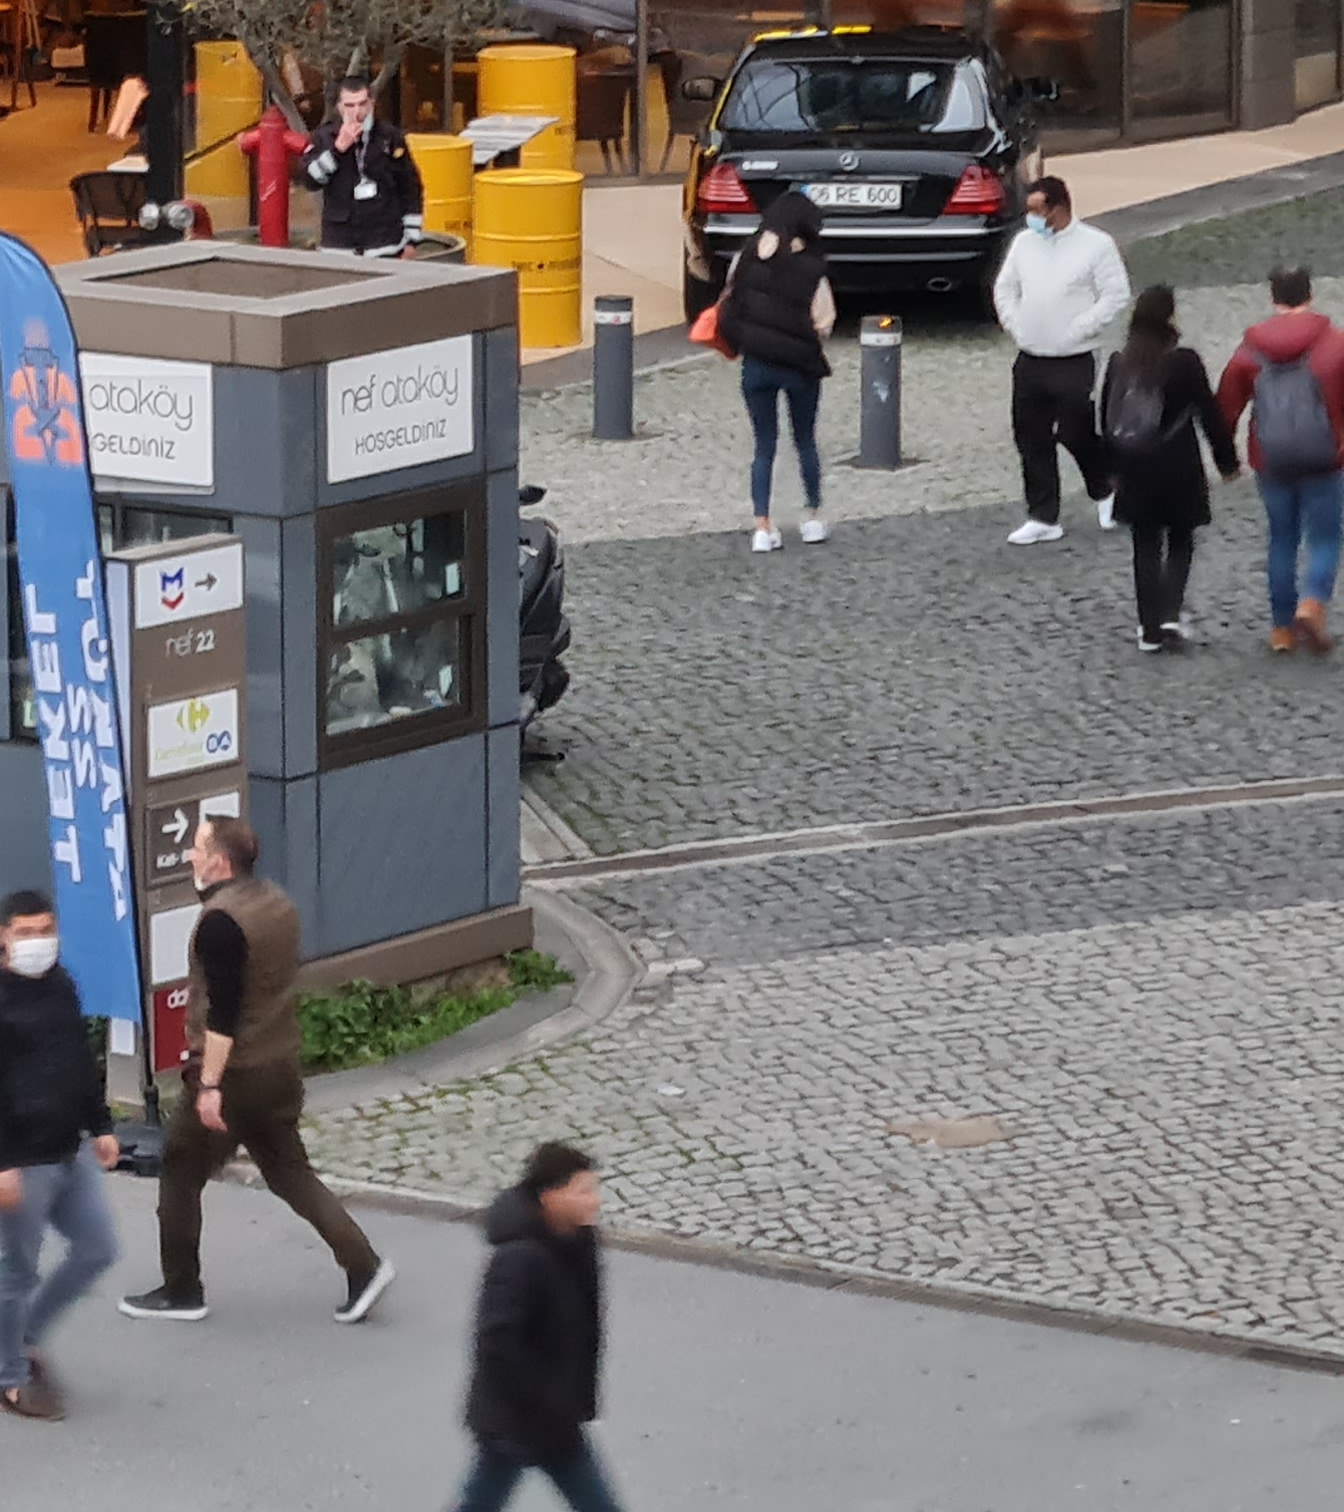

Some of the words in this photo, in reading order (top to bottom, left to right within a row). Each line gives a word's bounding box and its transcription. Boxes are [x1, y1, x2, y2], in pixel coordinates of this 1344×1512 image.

[835, 187, 861, 204] RE
[868, 187, 898, 204] 600
[89, 378, 193, 431] ataköy
[341, 373, 377, 415] nef
[381, 364, 458, 406] ataköy
[195, 629, 215, 653] 22
